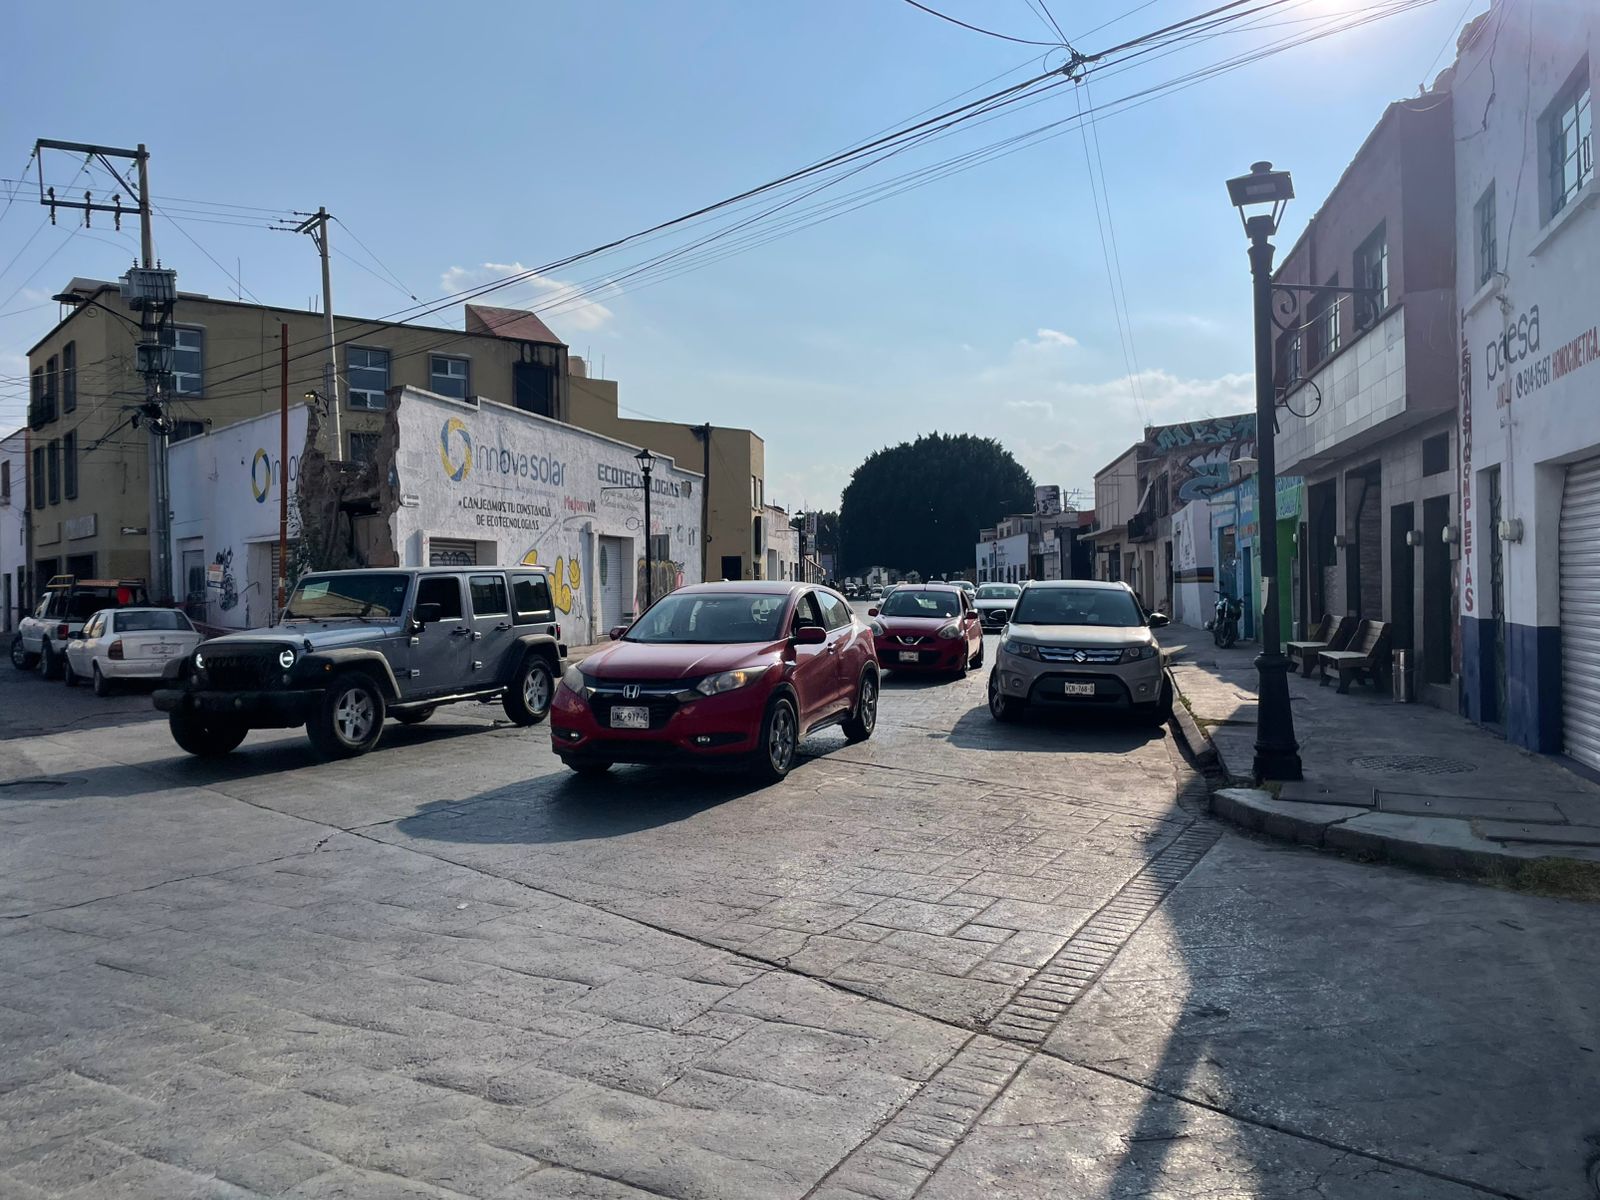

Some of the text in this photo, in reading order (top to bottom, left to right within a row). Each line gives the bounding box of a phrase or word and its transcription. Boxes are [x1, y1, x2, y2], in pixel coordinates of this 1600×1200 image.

[597, 463, 680, 499] ECOTECNLOGIAS
[463, 496, 506, 513] CANJEAMOS
[475, 514, 540, 531] DE ECOTECNOLOGIAS
